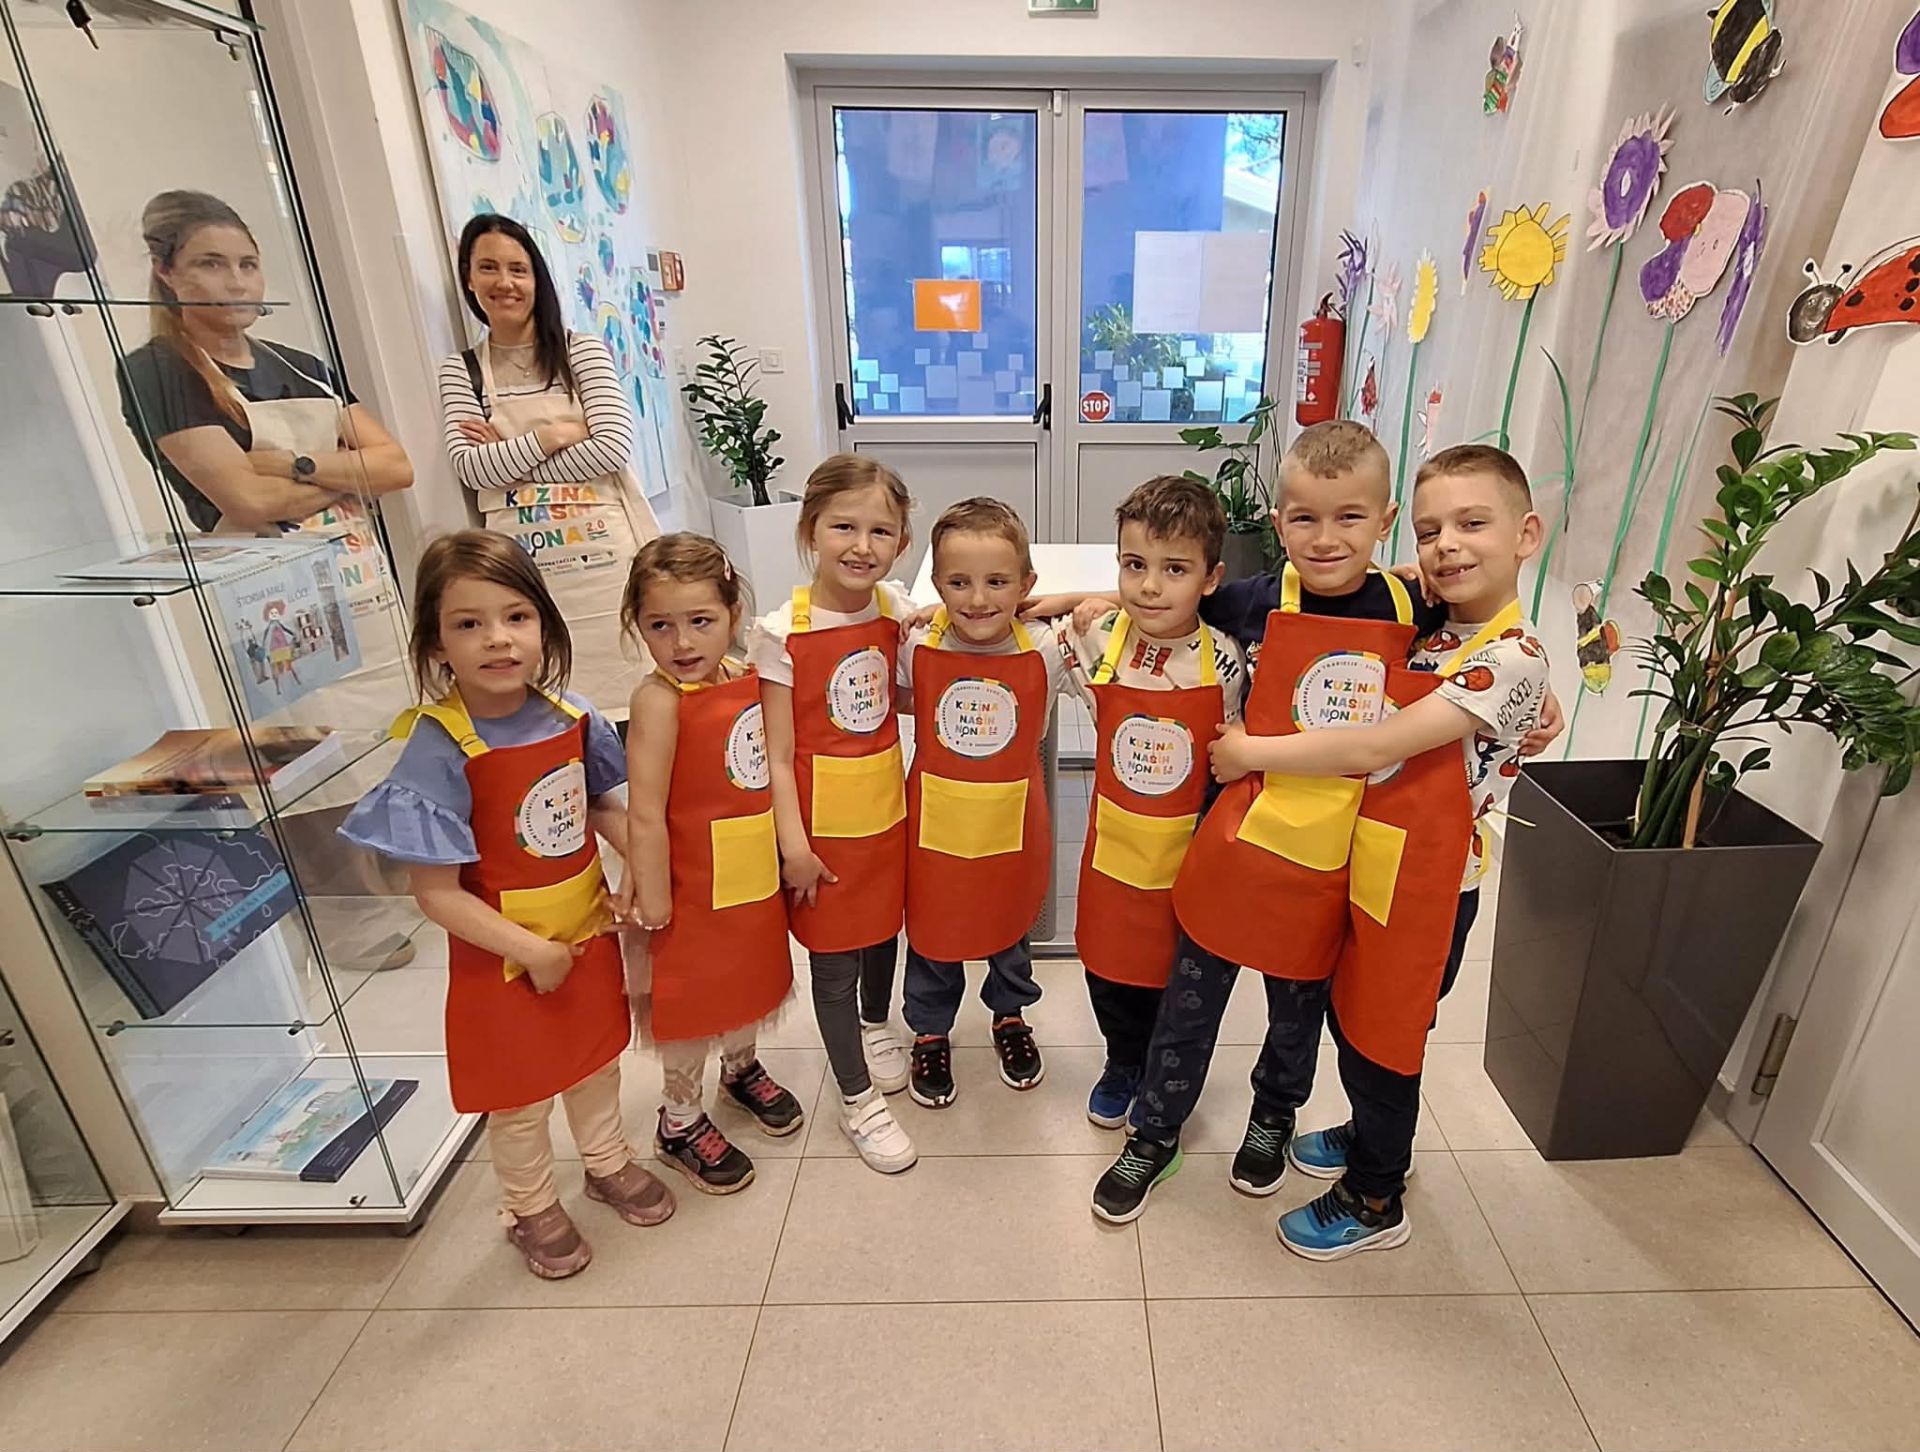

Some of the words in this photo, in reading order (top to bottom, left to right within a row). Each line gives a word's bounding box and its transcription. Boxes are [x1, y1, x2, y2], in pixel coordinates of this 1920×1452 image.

[1083, 400, 1109, 412] STOP
[1142, 645, 1157, 669] TNT
[1324, 678, 1377, 693] KUŽINA
[956, 700, 999, 711] KUŽINA
[1320, 709, 1359, 723] NONA
[955, 725, 987, 738] NONA
[1129, 736, 1174, 751] KUŽINA
[1128, 761, 1160, 774] NONA
